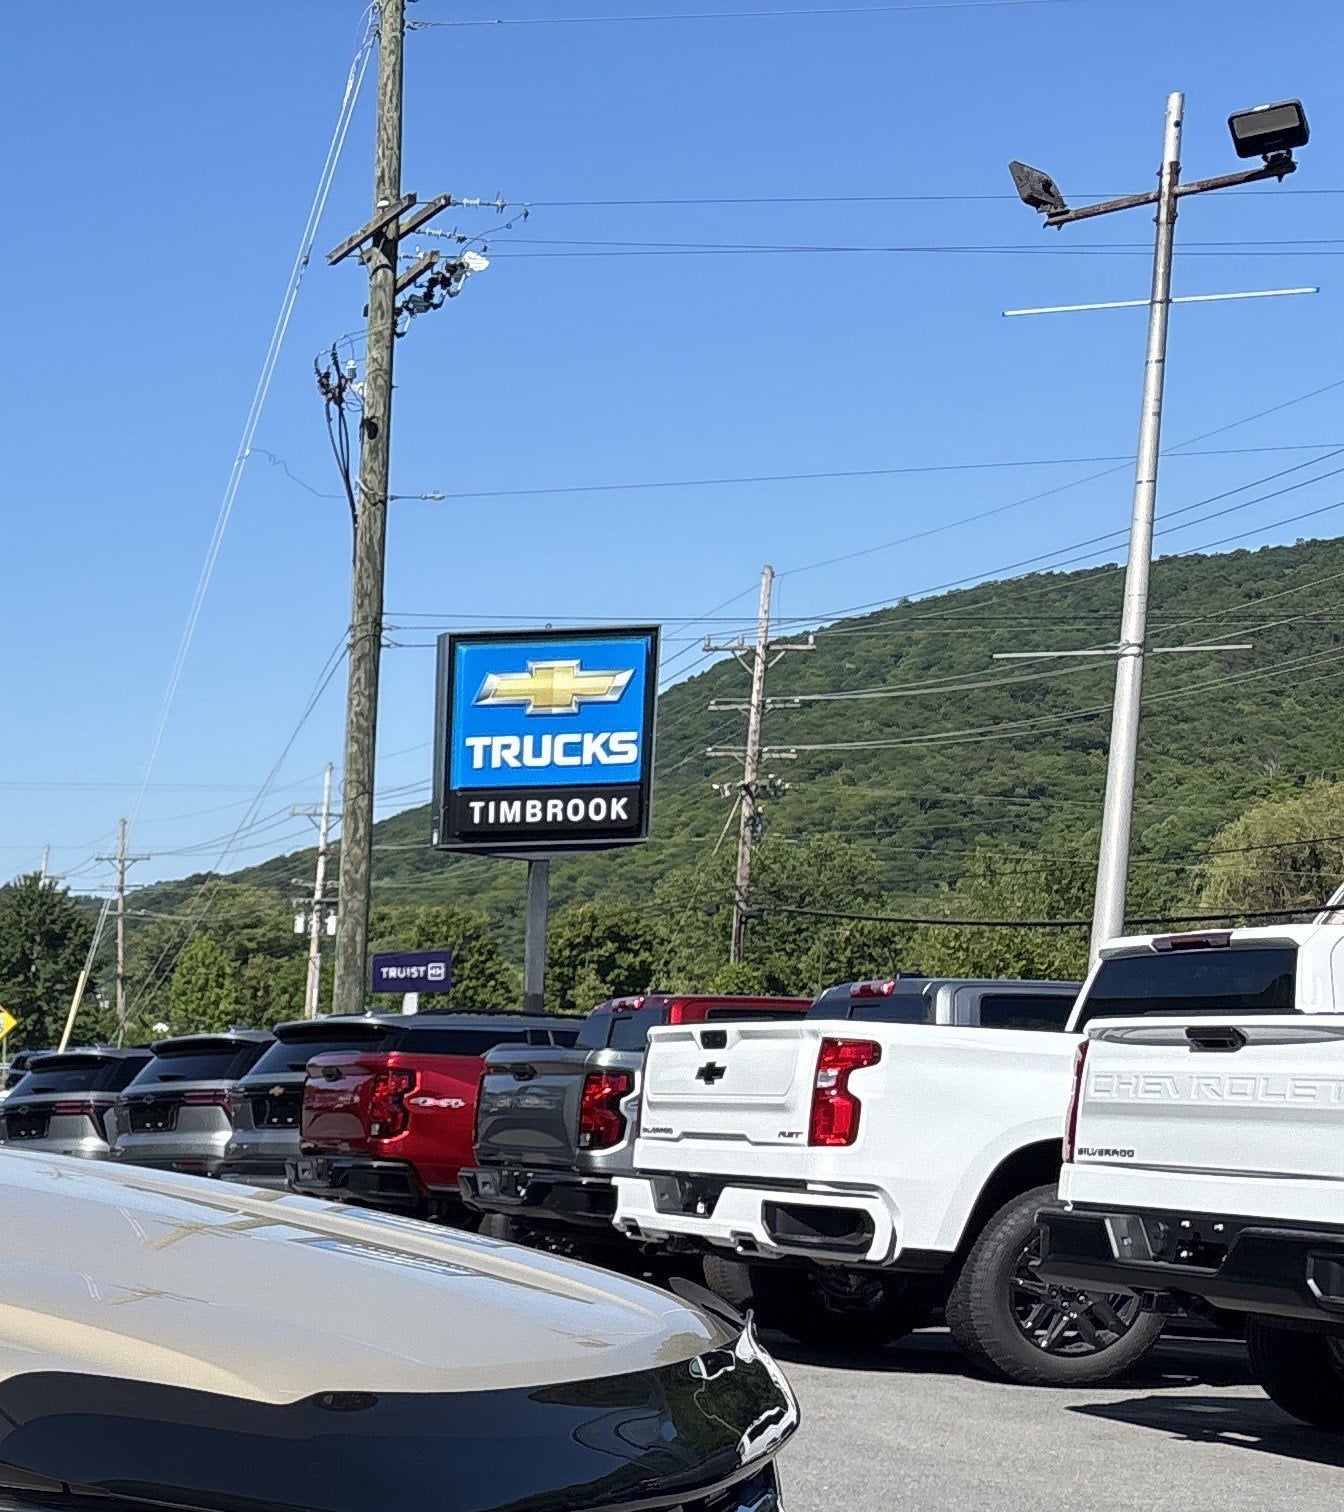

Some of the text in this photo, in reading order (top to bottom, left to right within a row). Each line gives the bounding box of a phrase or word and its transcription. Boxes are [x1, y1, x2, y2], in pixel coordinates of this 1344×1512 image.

[465, 731, 638, 769] TRUCKS
[469, 796, 629, 825] TIMBROOK
[380, 965, 427, 980] TRUIST
[1090, 1073, 1344, 1106] CHEVROLET
[1077, 1147, 1135, 1158] SILVERADO
